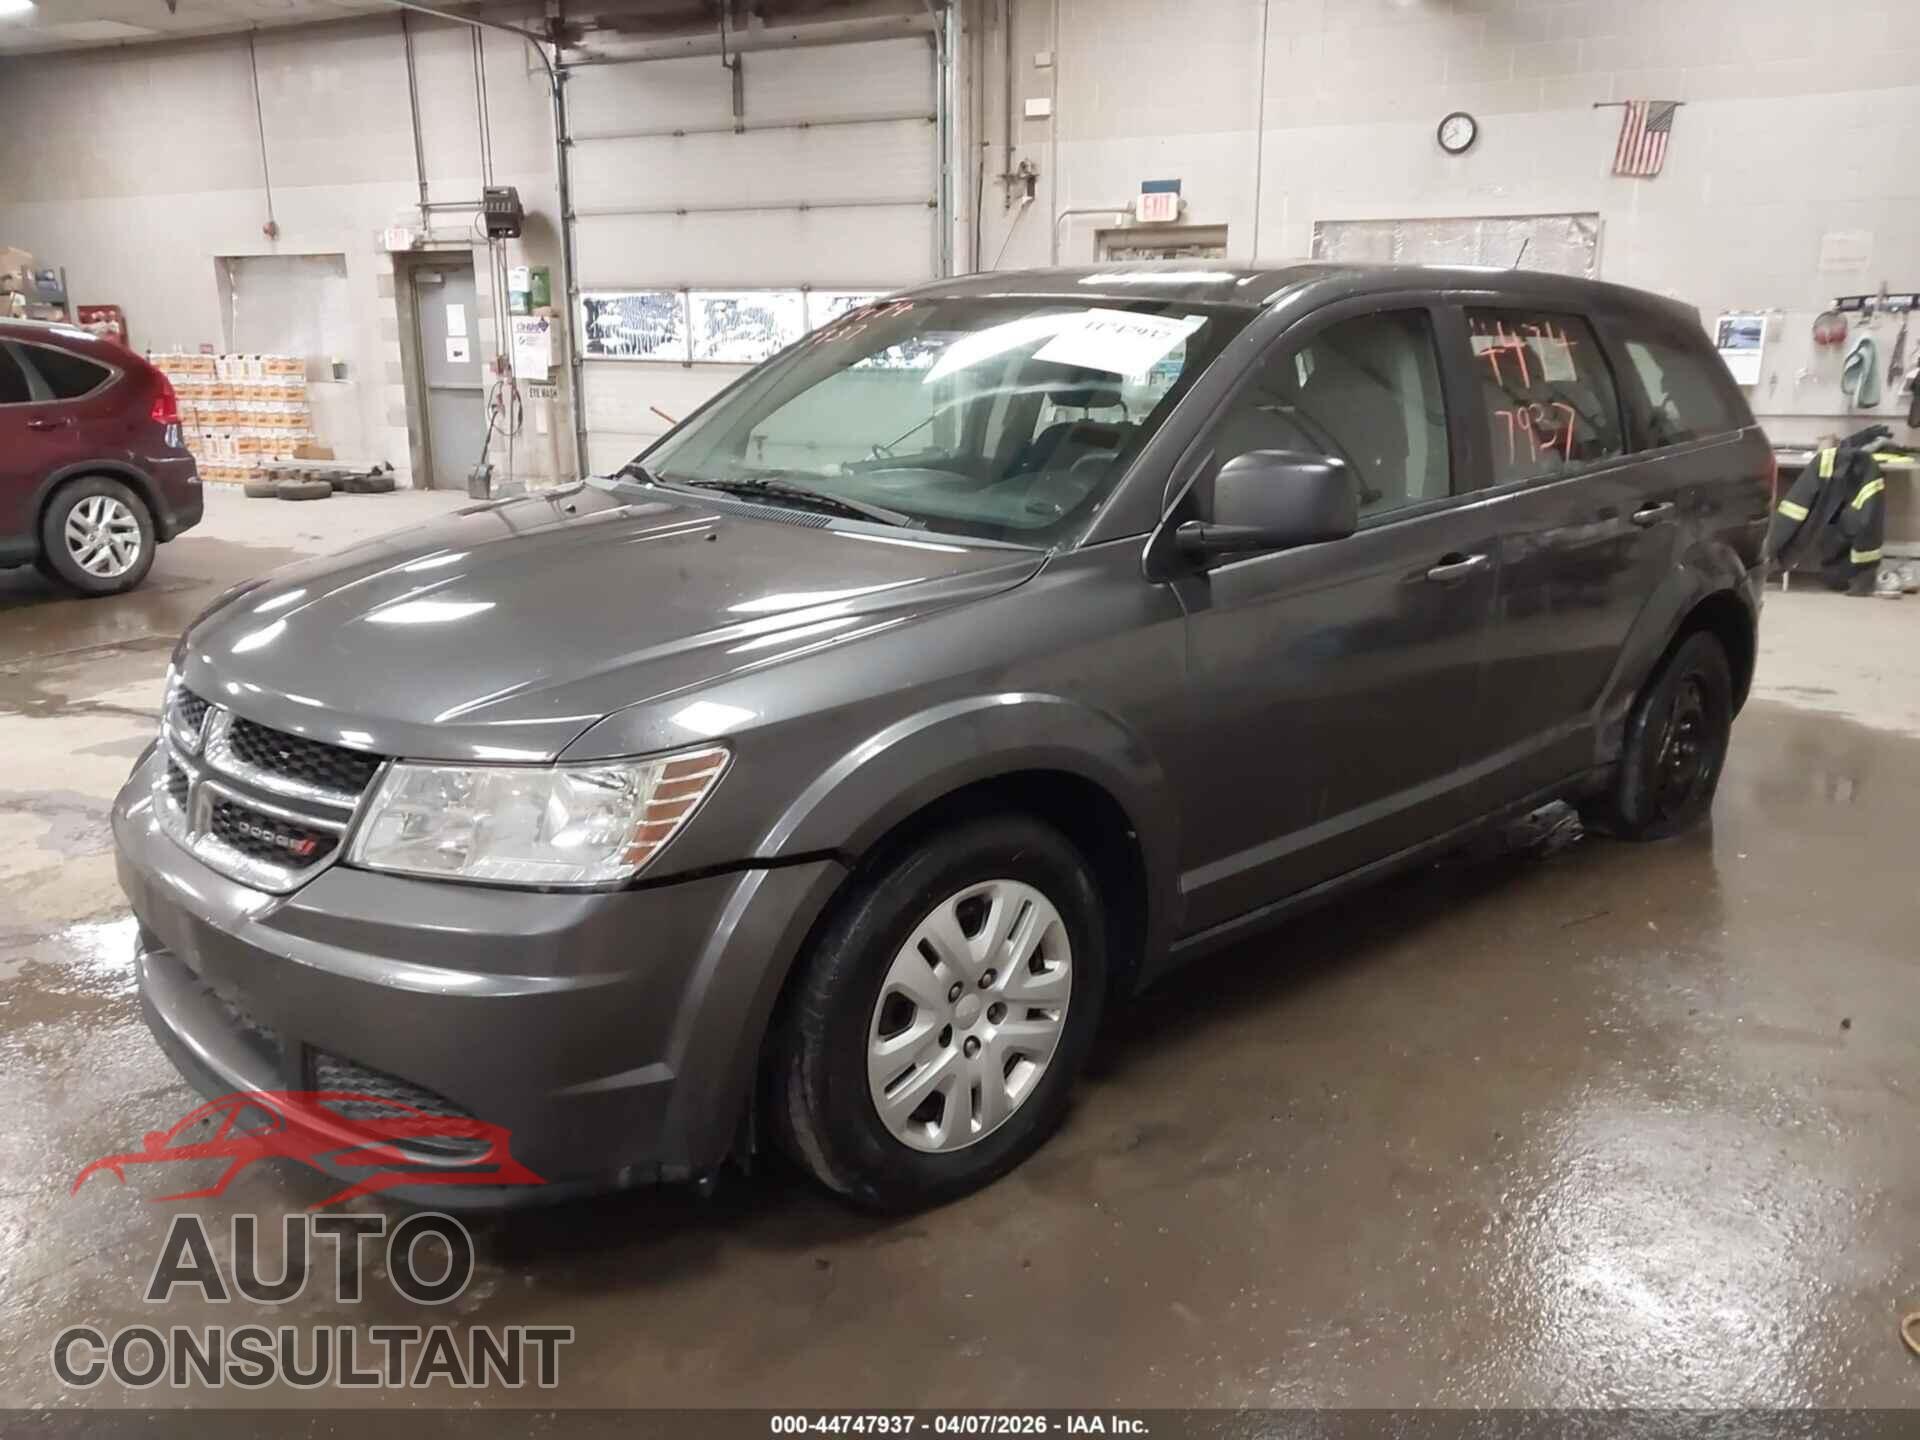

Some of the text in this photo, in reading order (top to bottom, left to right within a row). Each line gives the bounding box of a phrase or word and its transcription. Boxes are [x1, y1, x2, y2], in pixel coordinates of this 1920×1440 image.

[1143, 195, 1171, 218] EXIT
[529, 387, 540, 398] EYE
[1494, 402, 1576, 464] 7937
